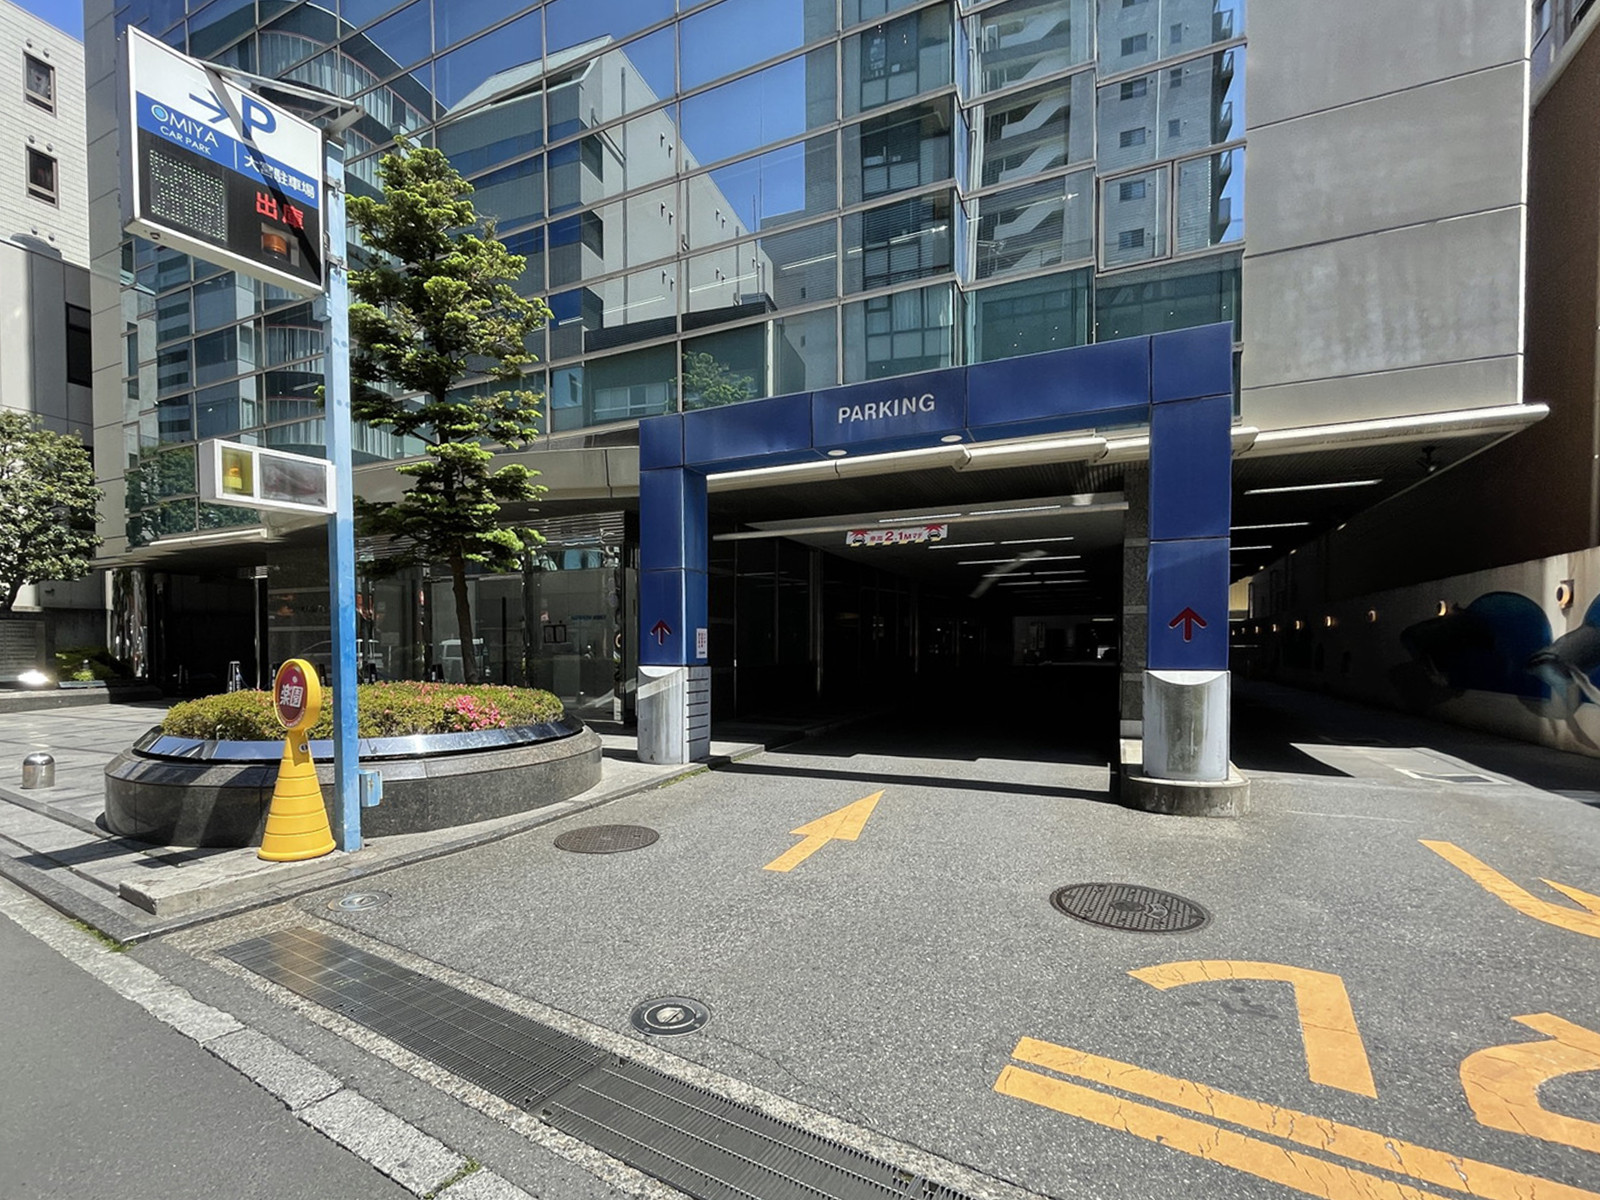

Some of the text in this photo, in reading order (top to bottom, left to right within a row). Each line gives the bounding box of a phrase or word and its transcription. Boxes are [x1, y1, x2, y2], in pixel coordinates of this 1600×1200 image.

[151, 104, 219, 148] OMIYA
[242, 94, 276, 140] P
[160, 125, 212, 156] CAR PARK
[243, 154, 315, 199] 大宮駐車場
[256, 191, 304, 230] 出庫
[838, 393, 935, 424] PARKING
[280, 683, 303, 708] 楽園
